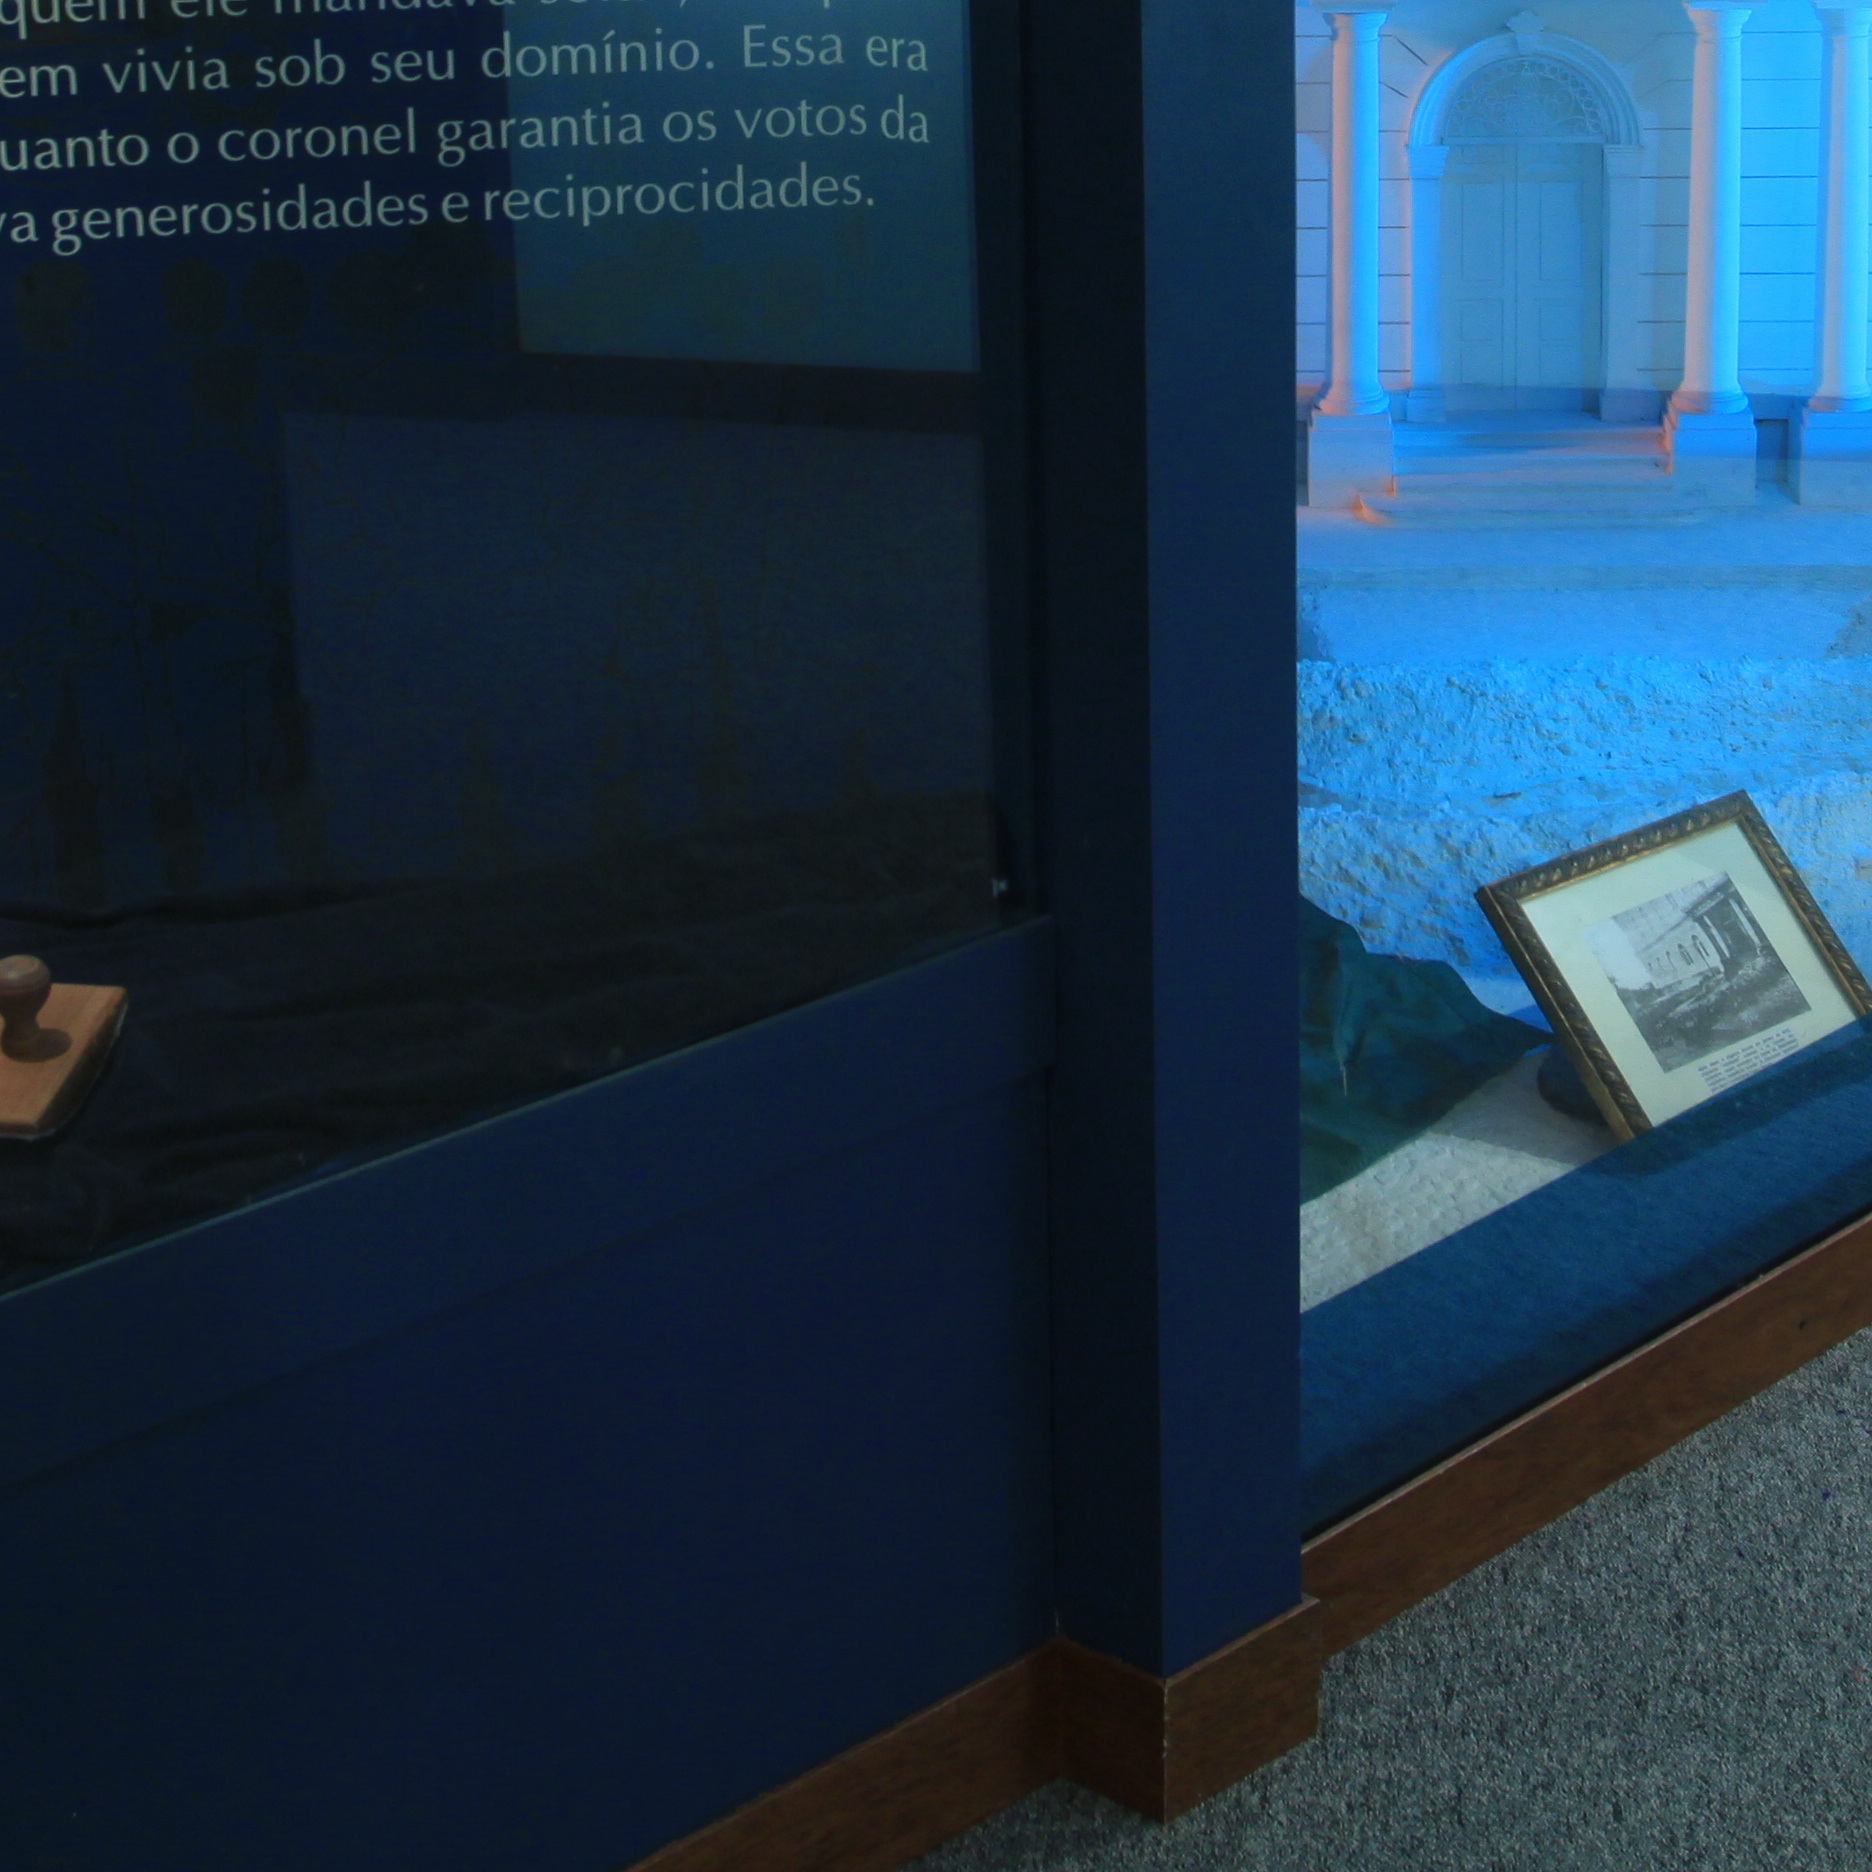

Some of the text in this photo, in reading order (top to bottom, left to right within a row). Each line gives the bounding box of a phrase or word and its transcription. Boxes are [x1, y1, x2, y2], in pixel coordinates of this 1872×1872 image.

[50, 179, 430, 258] generosidades
[440, 191, 471, 225] e
[483, 160, 875, 228] reciprocidades.
